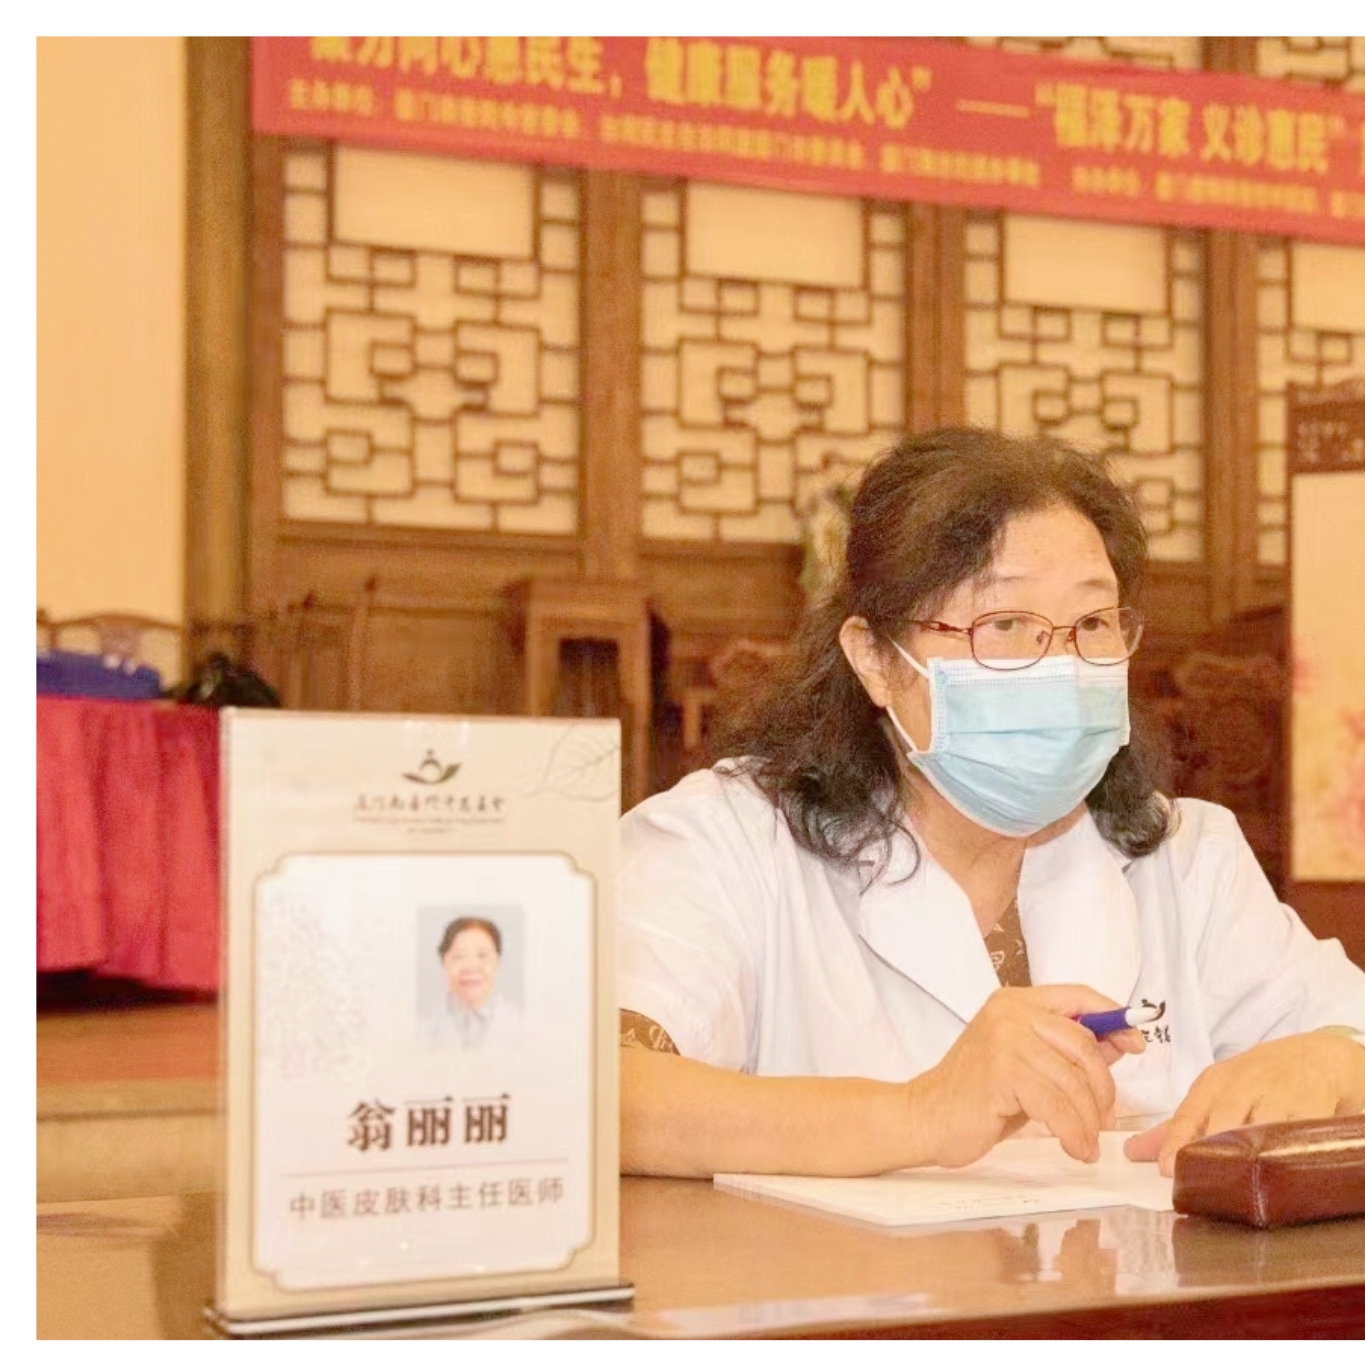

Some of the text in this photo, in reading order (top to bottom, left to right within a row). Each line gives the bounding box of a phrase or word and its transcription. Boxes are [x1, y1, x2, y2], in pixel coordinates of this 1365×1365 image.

[346, 1093, 511, 1153] 翁丽丽
[288, 1175, 564, 1221] 中医皮肤科主任医师
